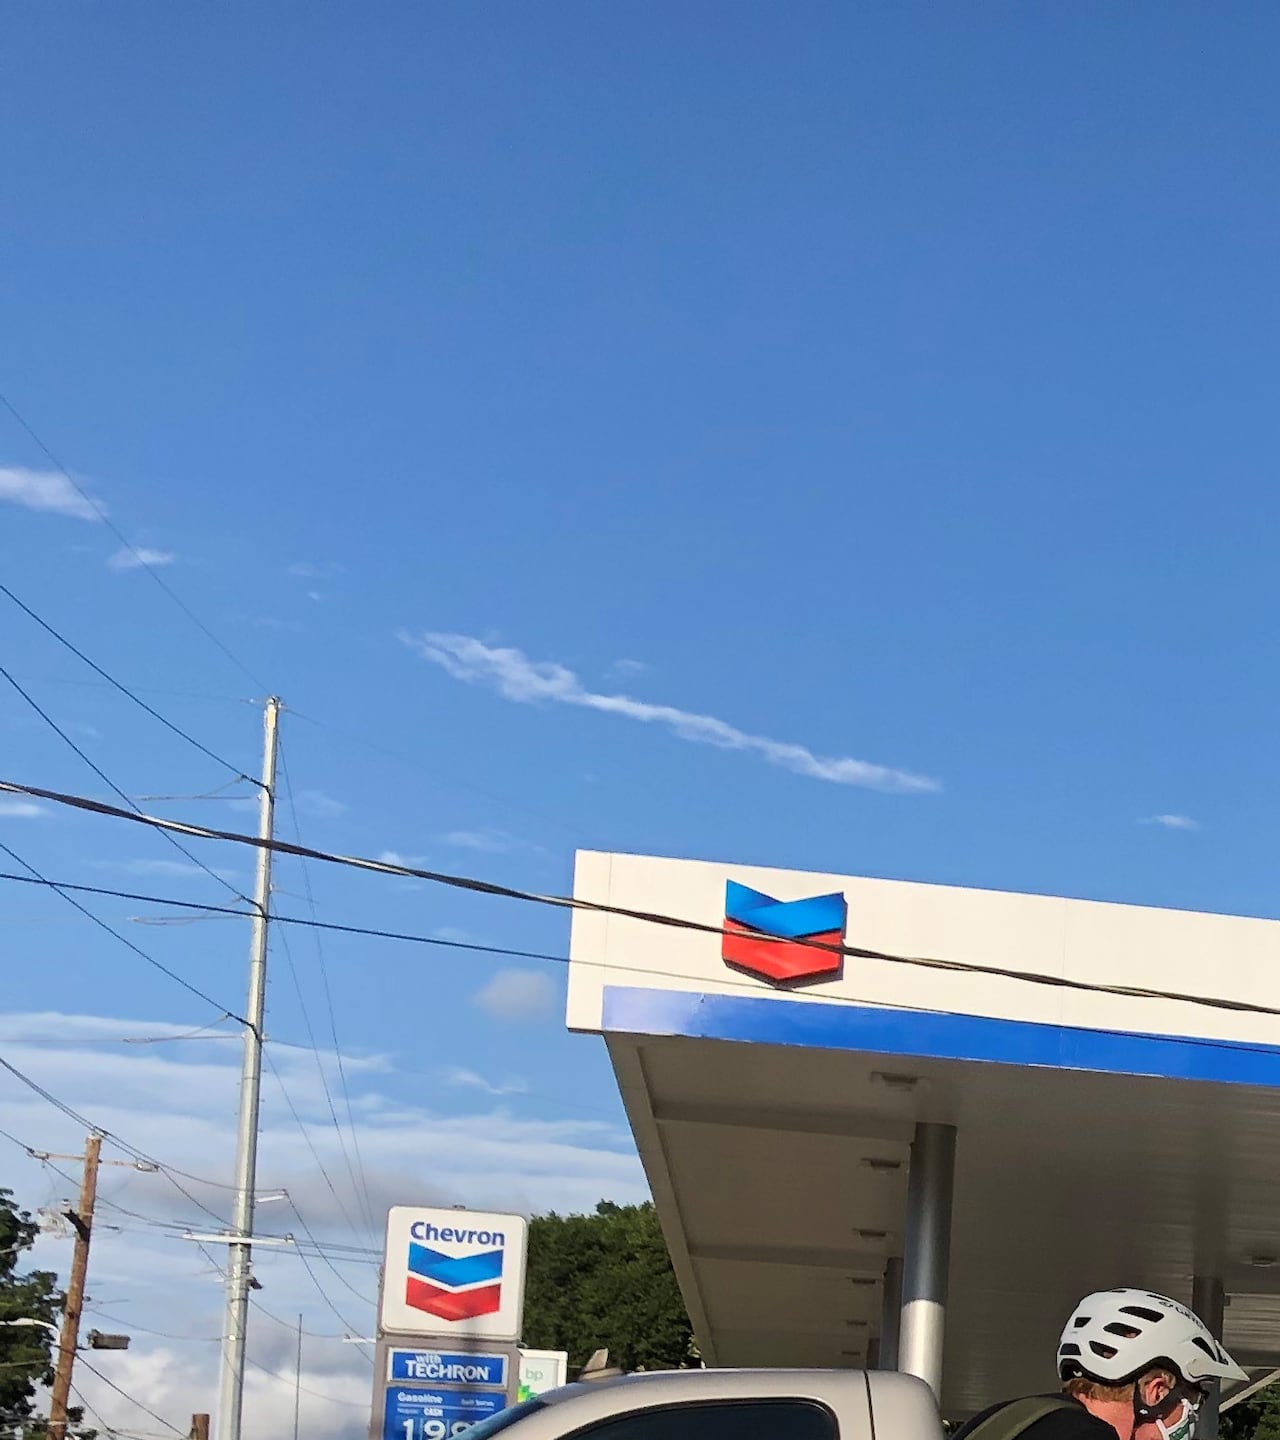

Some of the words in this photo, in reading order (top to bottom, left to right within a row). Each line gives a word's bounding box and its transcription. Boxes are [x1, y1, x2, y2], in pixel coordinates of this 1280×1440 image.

[410, 1220, 505, 1246] Chevron
[415, 1353, 442, 1364] with
[405, 1359, 490, 1383] TECHRON
[525, 1367, 544, 1381] bp
[397, 1391, 443, 1404] Gasoline
